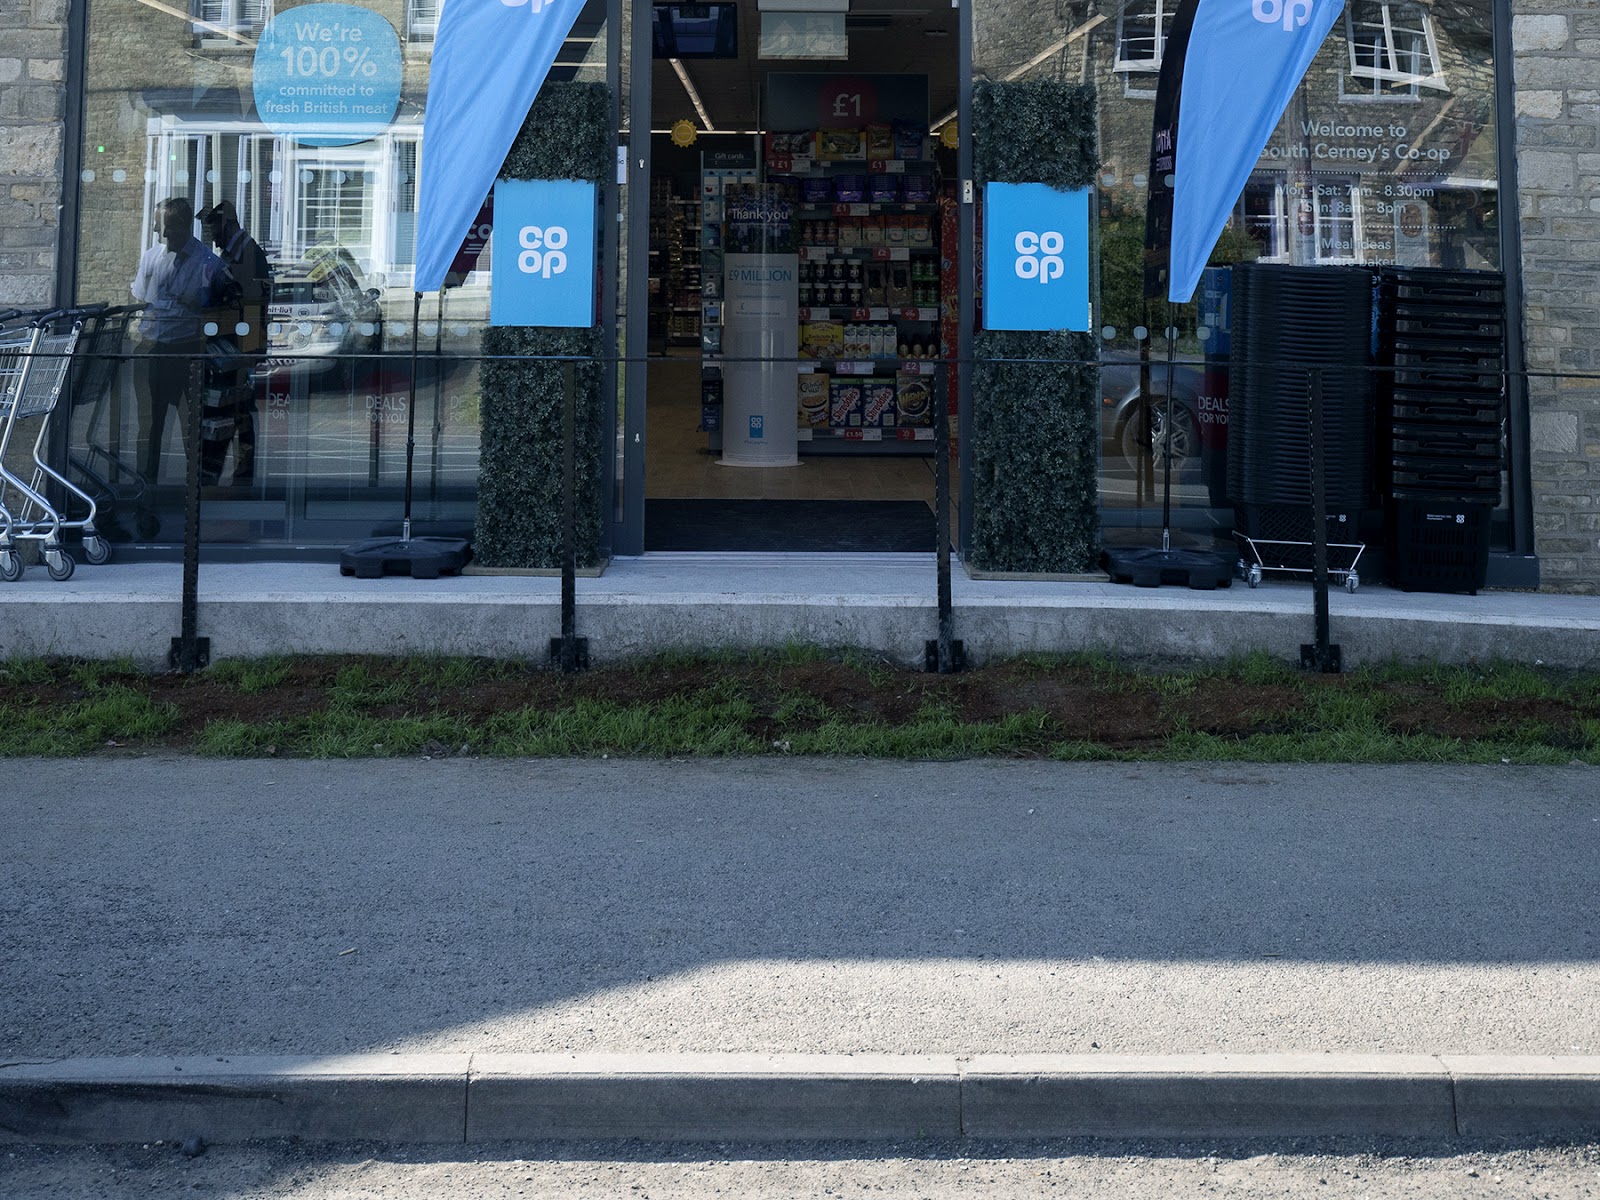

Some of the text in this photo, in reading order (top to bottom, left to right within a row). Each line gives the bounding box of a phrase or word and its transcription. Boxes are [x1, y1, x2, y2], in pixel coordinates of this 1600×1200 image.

[294, 21, 363, 42] We're
[279, 45, 378, 77] 100%
[279, 84, 375, 97] committed to
[264, 99, 388, 114] fresh British meat
[832, 93, 862, 117] £1
[1301, 120, 1407, 137] Welcome to
[1314, 143, 1391, 163] Cerney's
[1395, 143, 1451, 164] Co-op
[777, 161, 789, 169] £1
[871, 161, 883, 169] £1
[1276, 184, 1305, 196] Mon
[1317, 183, 1342, 196] Sat:
[1383, 183, 1435, 200] 8.30pm
[732, 208, 789, 222] Thank you
[835, 205, 848, 213] £1
[1376, 201, 1407, 216] 8pm
[1321, 238, 1392, 250] Meal ideas
[741, 269, 792, 281] MILLION
[855, 309, 867, 317] £1
[839, 361, 851, 370] £1
[905, 361, 917, 370] £2
[268, 392, 291, 407] DEA
[366, 395, 406, 411] DEALS
[833, 388, 858, 420] Shreddies
[866, 388, 891, 420] Shreddies
[365, 413, 407, 424] FOR YOU
[1198, 411, 1215, 423] FOR
